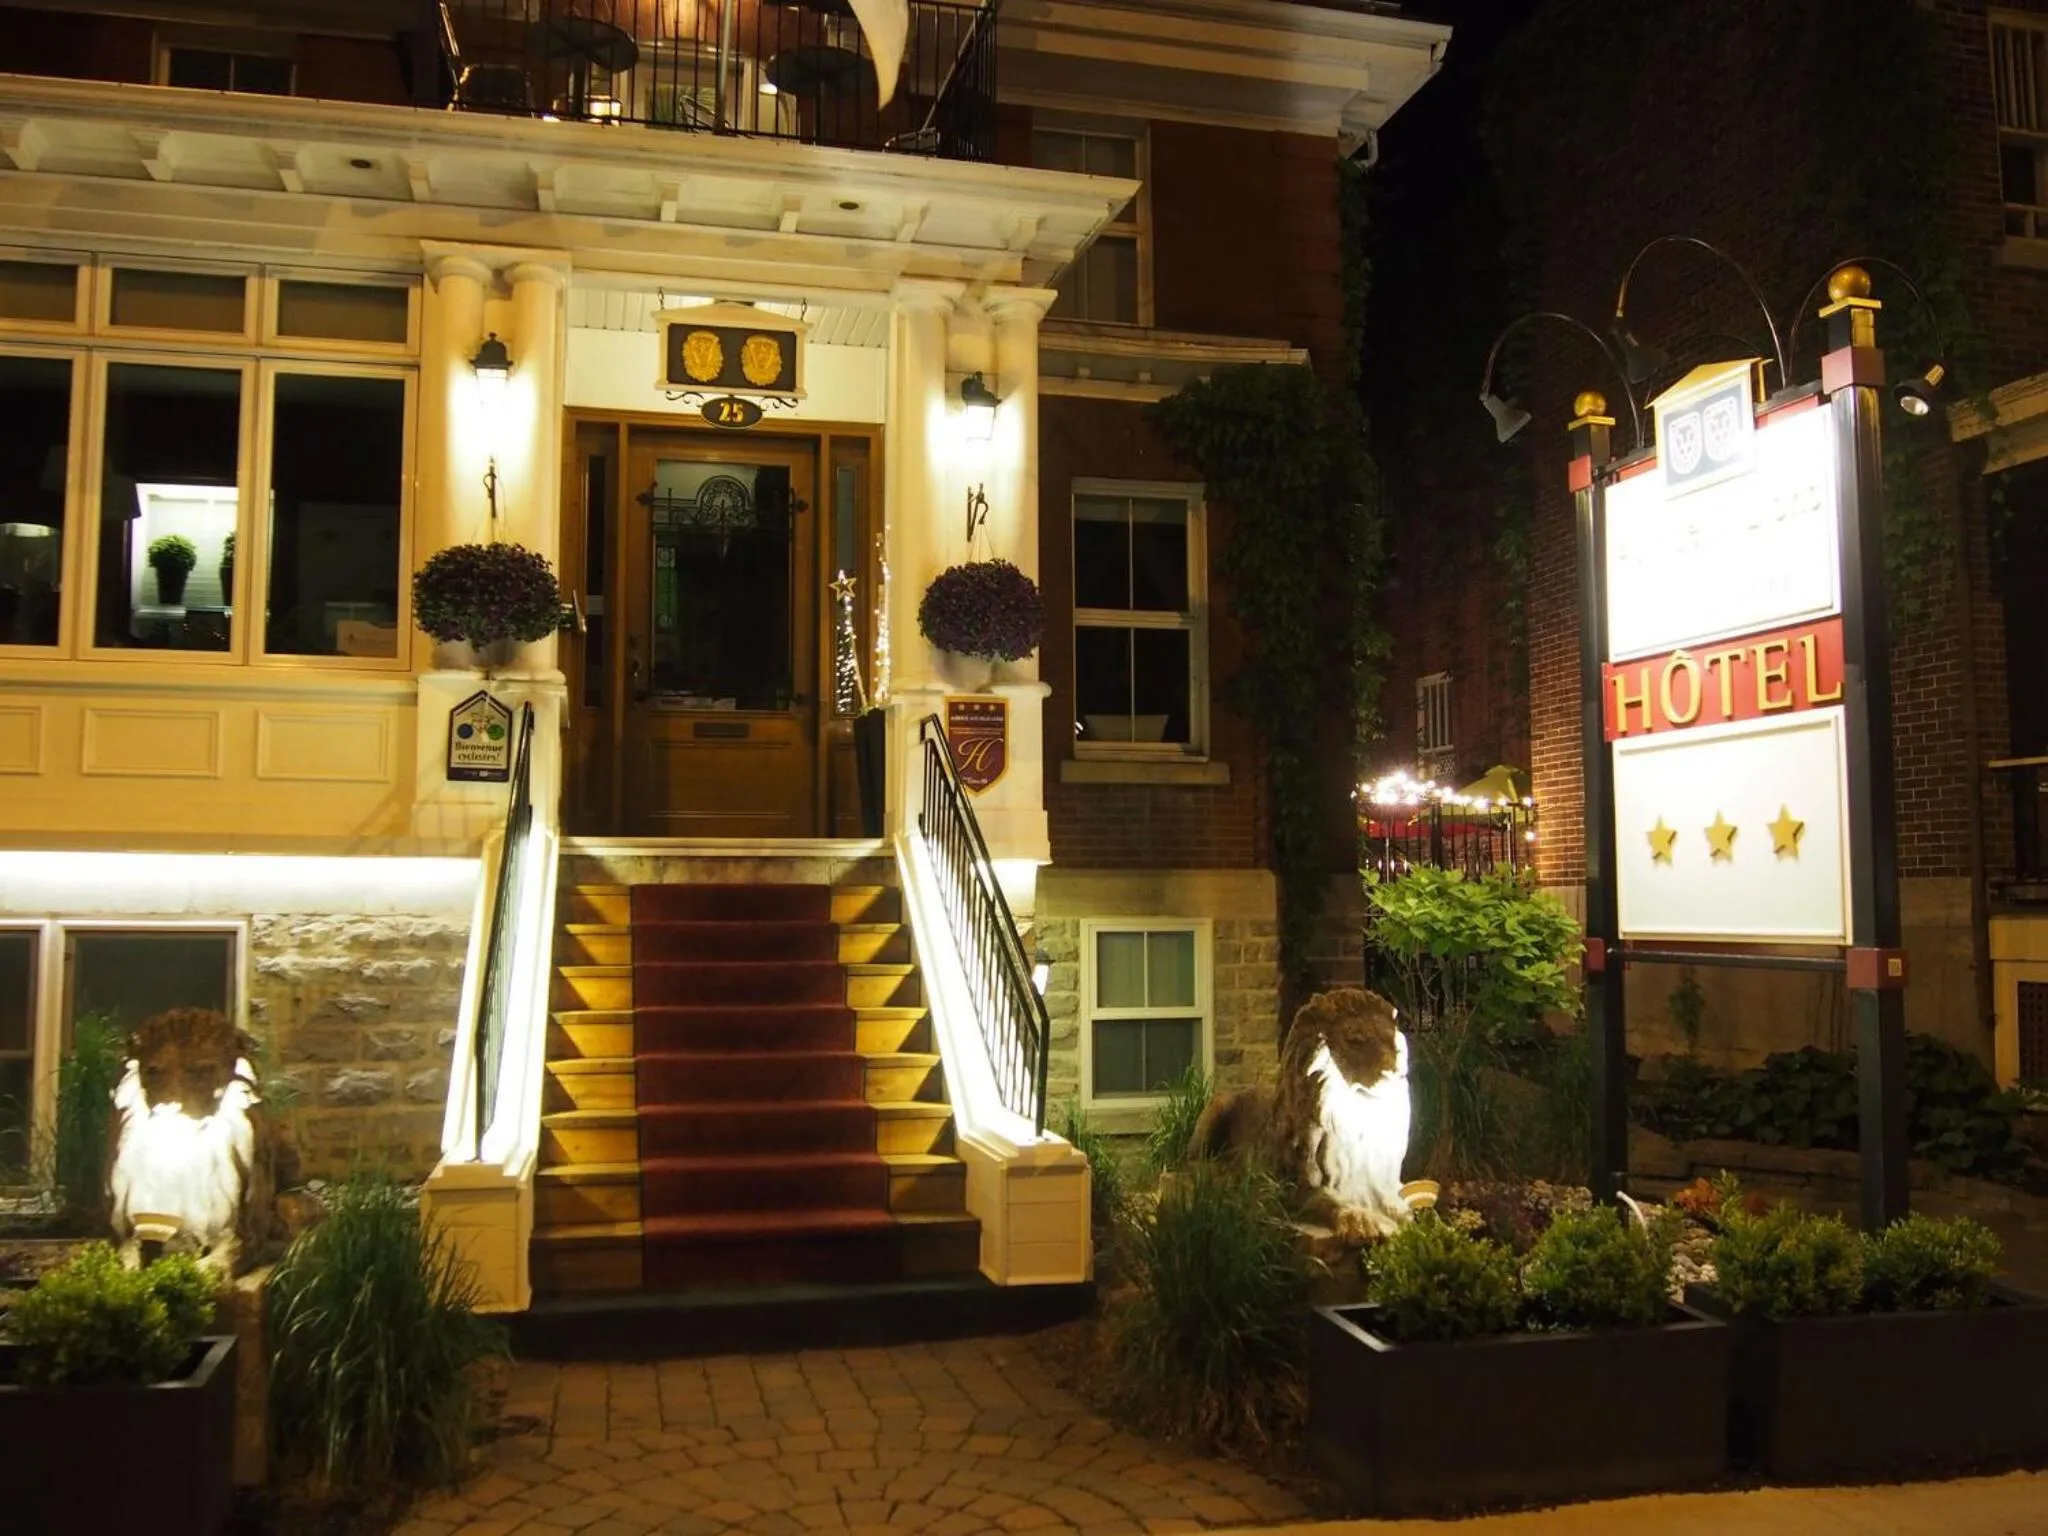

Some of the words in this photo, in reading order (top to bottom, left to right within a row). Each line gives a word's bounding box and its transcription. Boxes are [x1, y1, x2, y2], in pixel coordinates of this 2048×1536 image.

[719, 402, 743, 422] 25
[1612, 635, 1843, 732] HÔTEL
[455, 742, 503, 752] Bienvenue
[957, 738, 1003, 772] H
